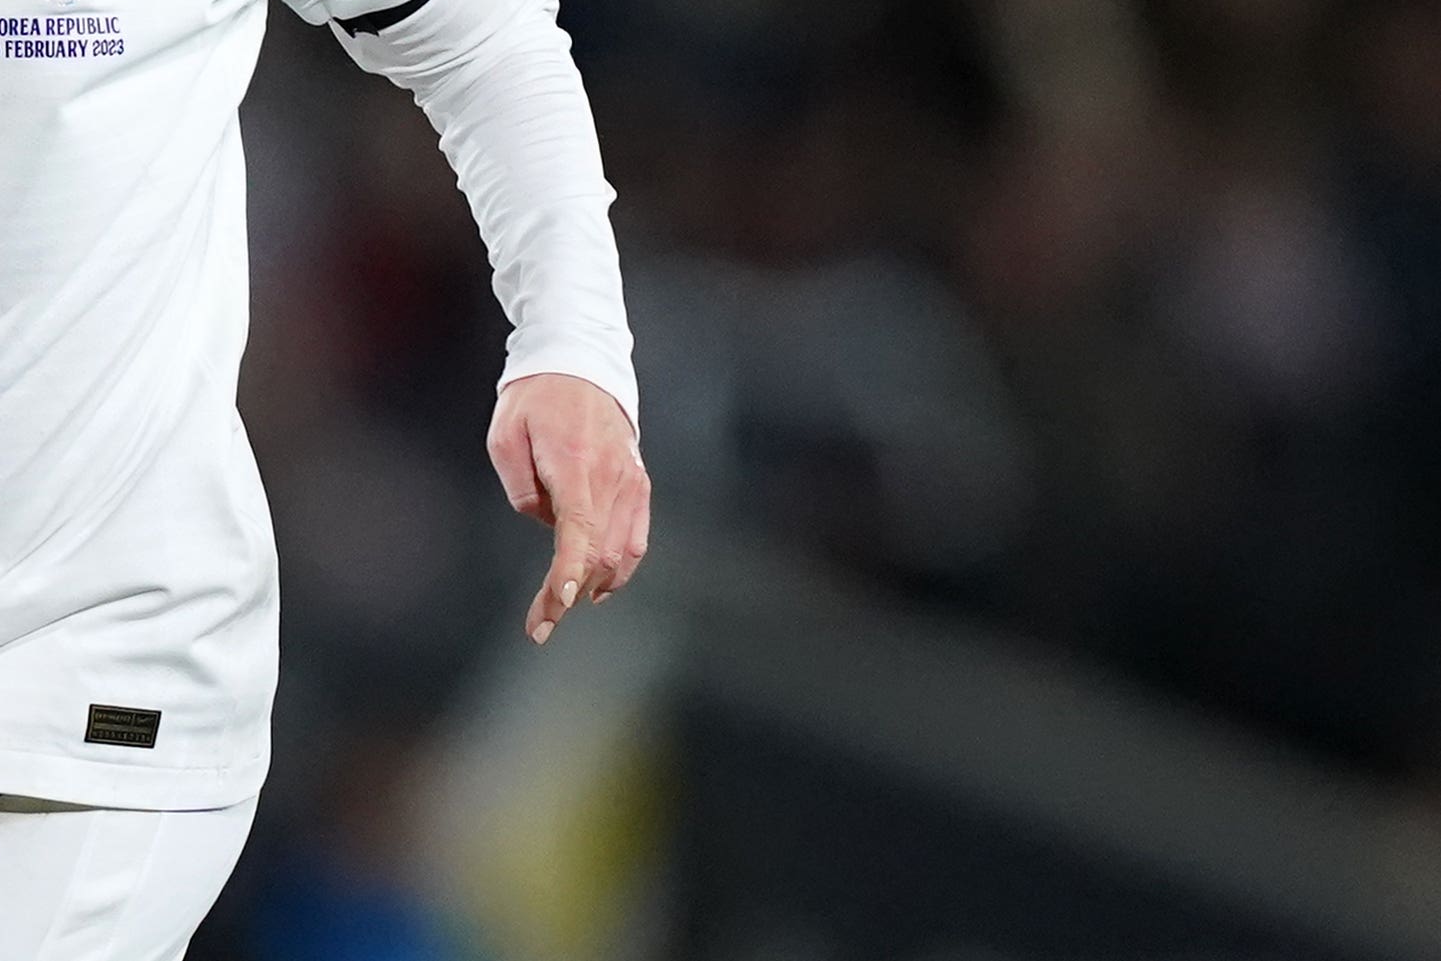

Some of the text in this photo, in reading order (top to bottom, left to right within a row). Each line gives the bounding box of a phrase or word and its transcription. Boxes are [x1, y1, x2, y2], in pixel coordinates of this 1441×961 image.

[46, 16, 120, 36] REPUBLIC
[5, 39, 89, 58] FEBRUARY
[92, 38, 125, 57] 2023
